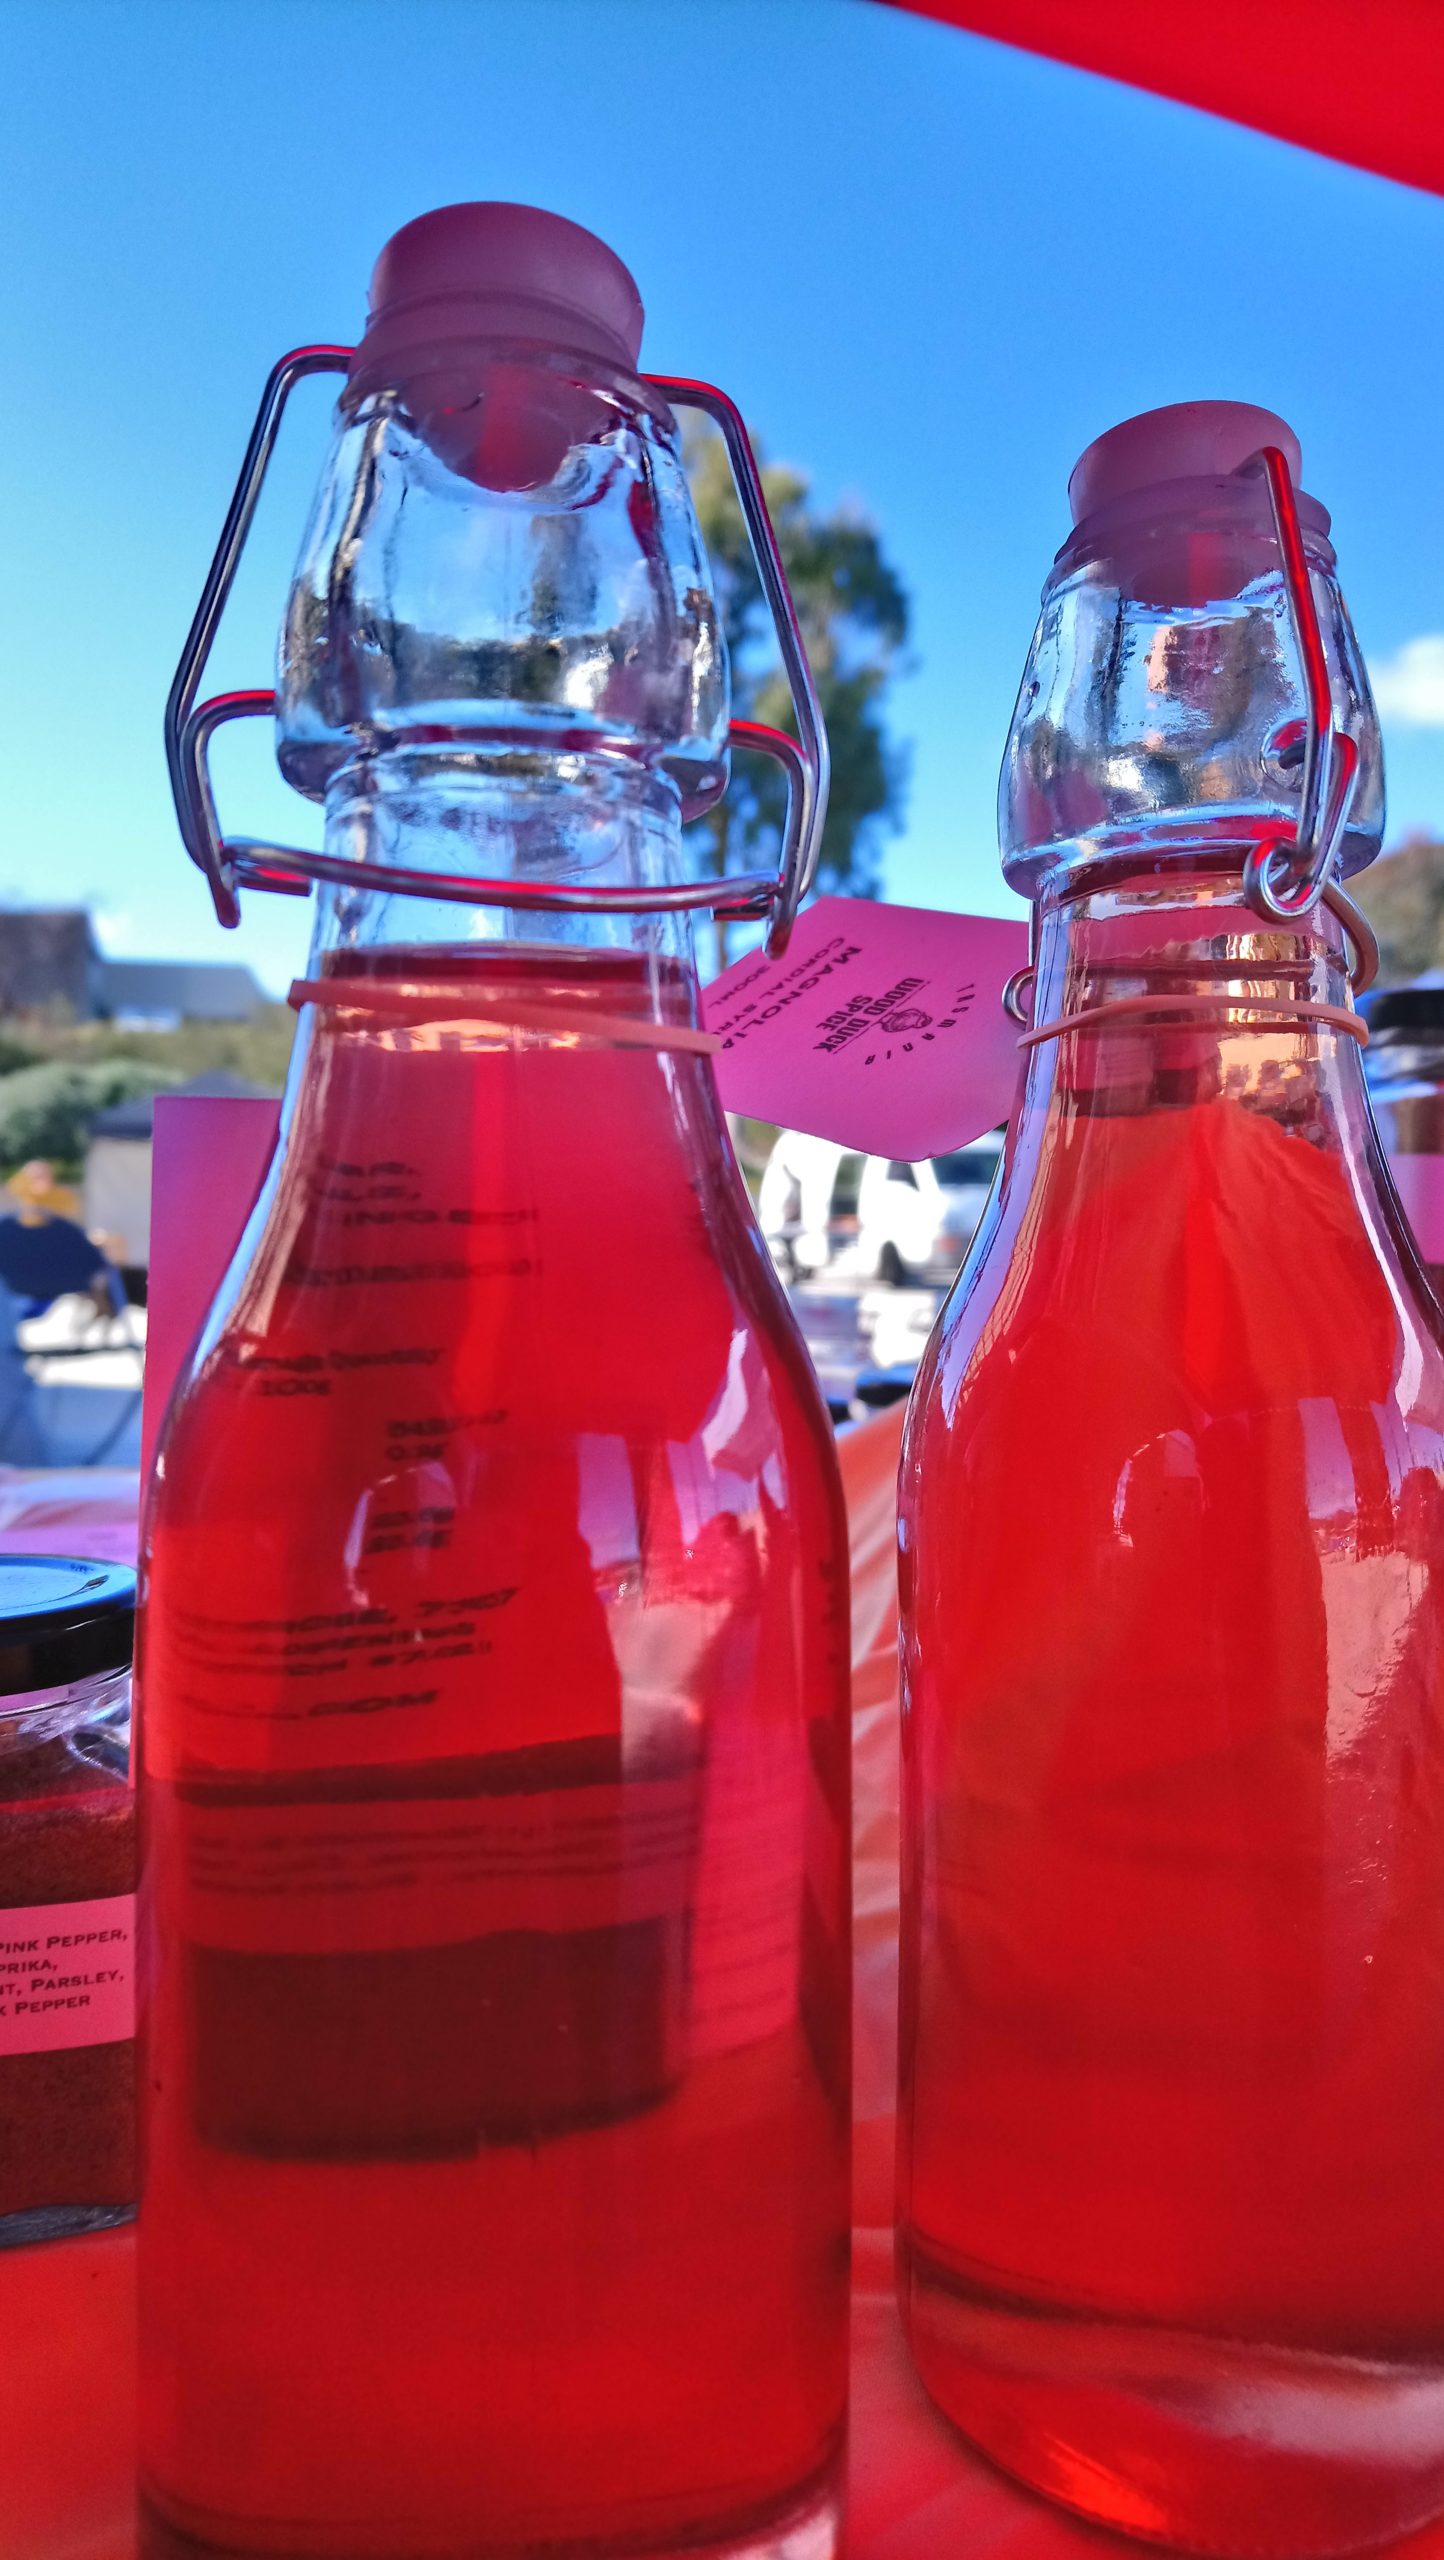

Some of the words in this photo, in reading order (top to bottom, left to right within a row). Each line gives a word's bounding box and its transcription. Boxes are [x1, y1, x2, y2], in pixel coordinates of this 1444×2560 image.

[758, 937, 845, 999] CORDIAL
[722, 946, 863, 1049] MAGNOLIA
[816, 995, 873, 1032] SPICE
[862, 977, 925, 1016] WOOD
[812, 1018, 871, 1053] DUCK
[46, 1929, 128, 1949] PEPPER,
[31, 1969, 124, 1992] PARSLEY,
[15, 1995, 91, 2015] PEPPER
